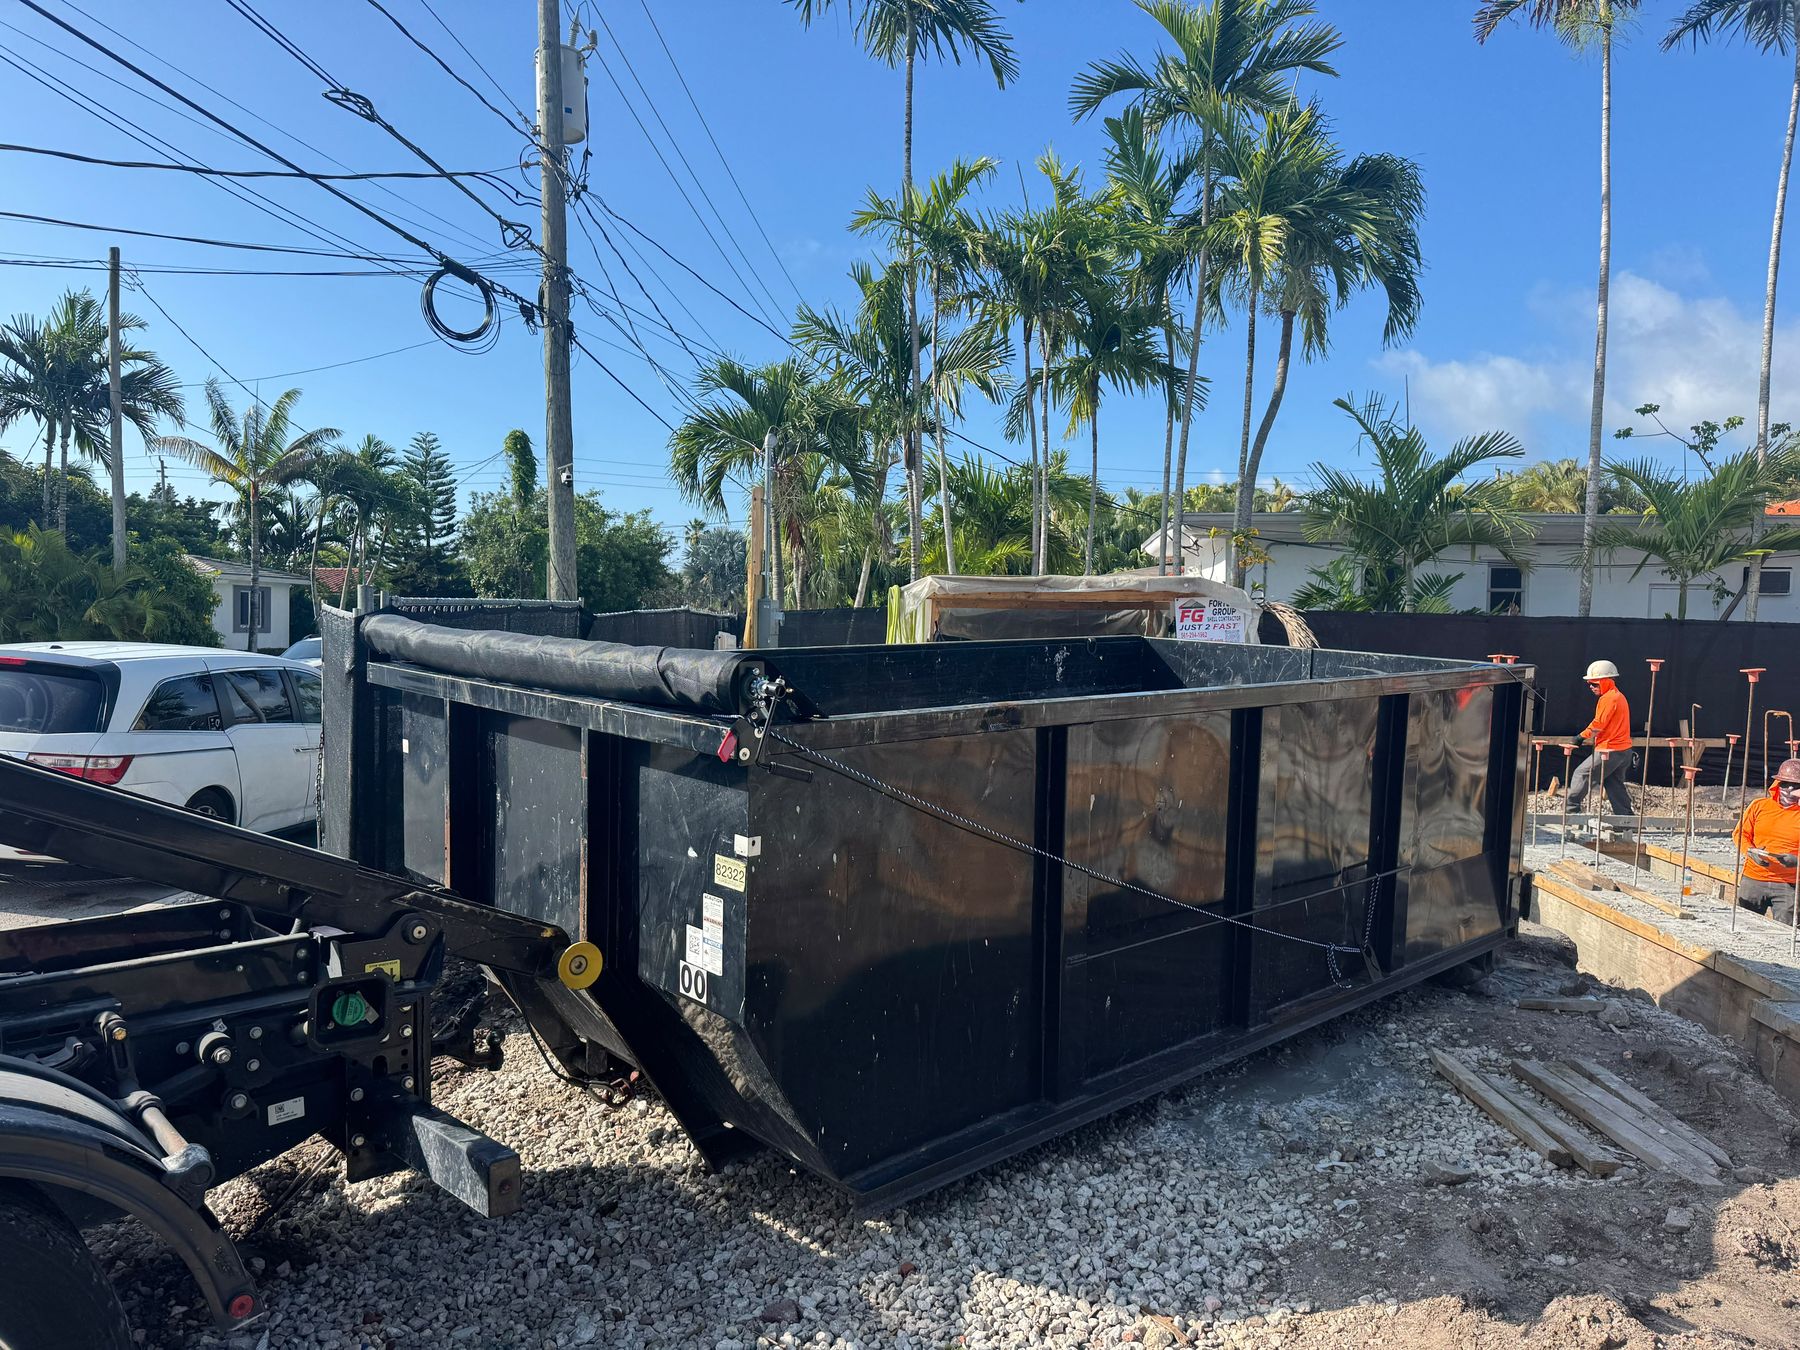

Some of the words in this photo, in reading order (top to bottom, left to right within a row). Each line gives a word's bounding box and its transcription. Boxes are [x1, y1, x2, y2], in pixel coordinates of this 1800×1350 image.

[1180, 609, 1205, 623] FG
[1212, 608, 1237, 616] GROUP
[715, 863, 745, 884] 82322
[681, 964, 706, 1000] 00
